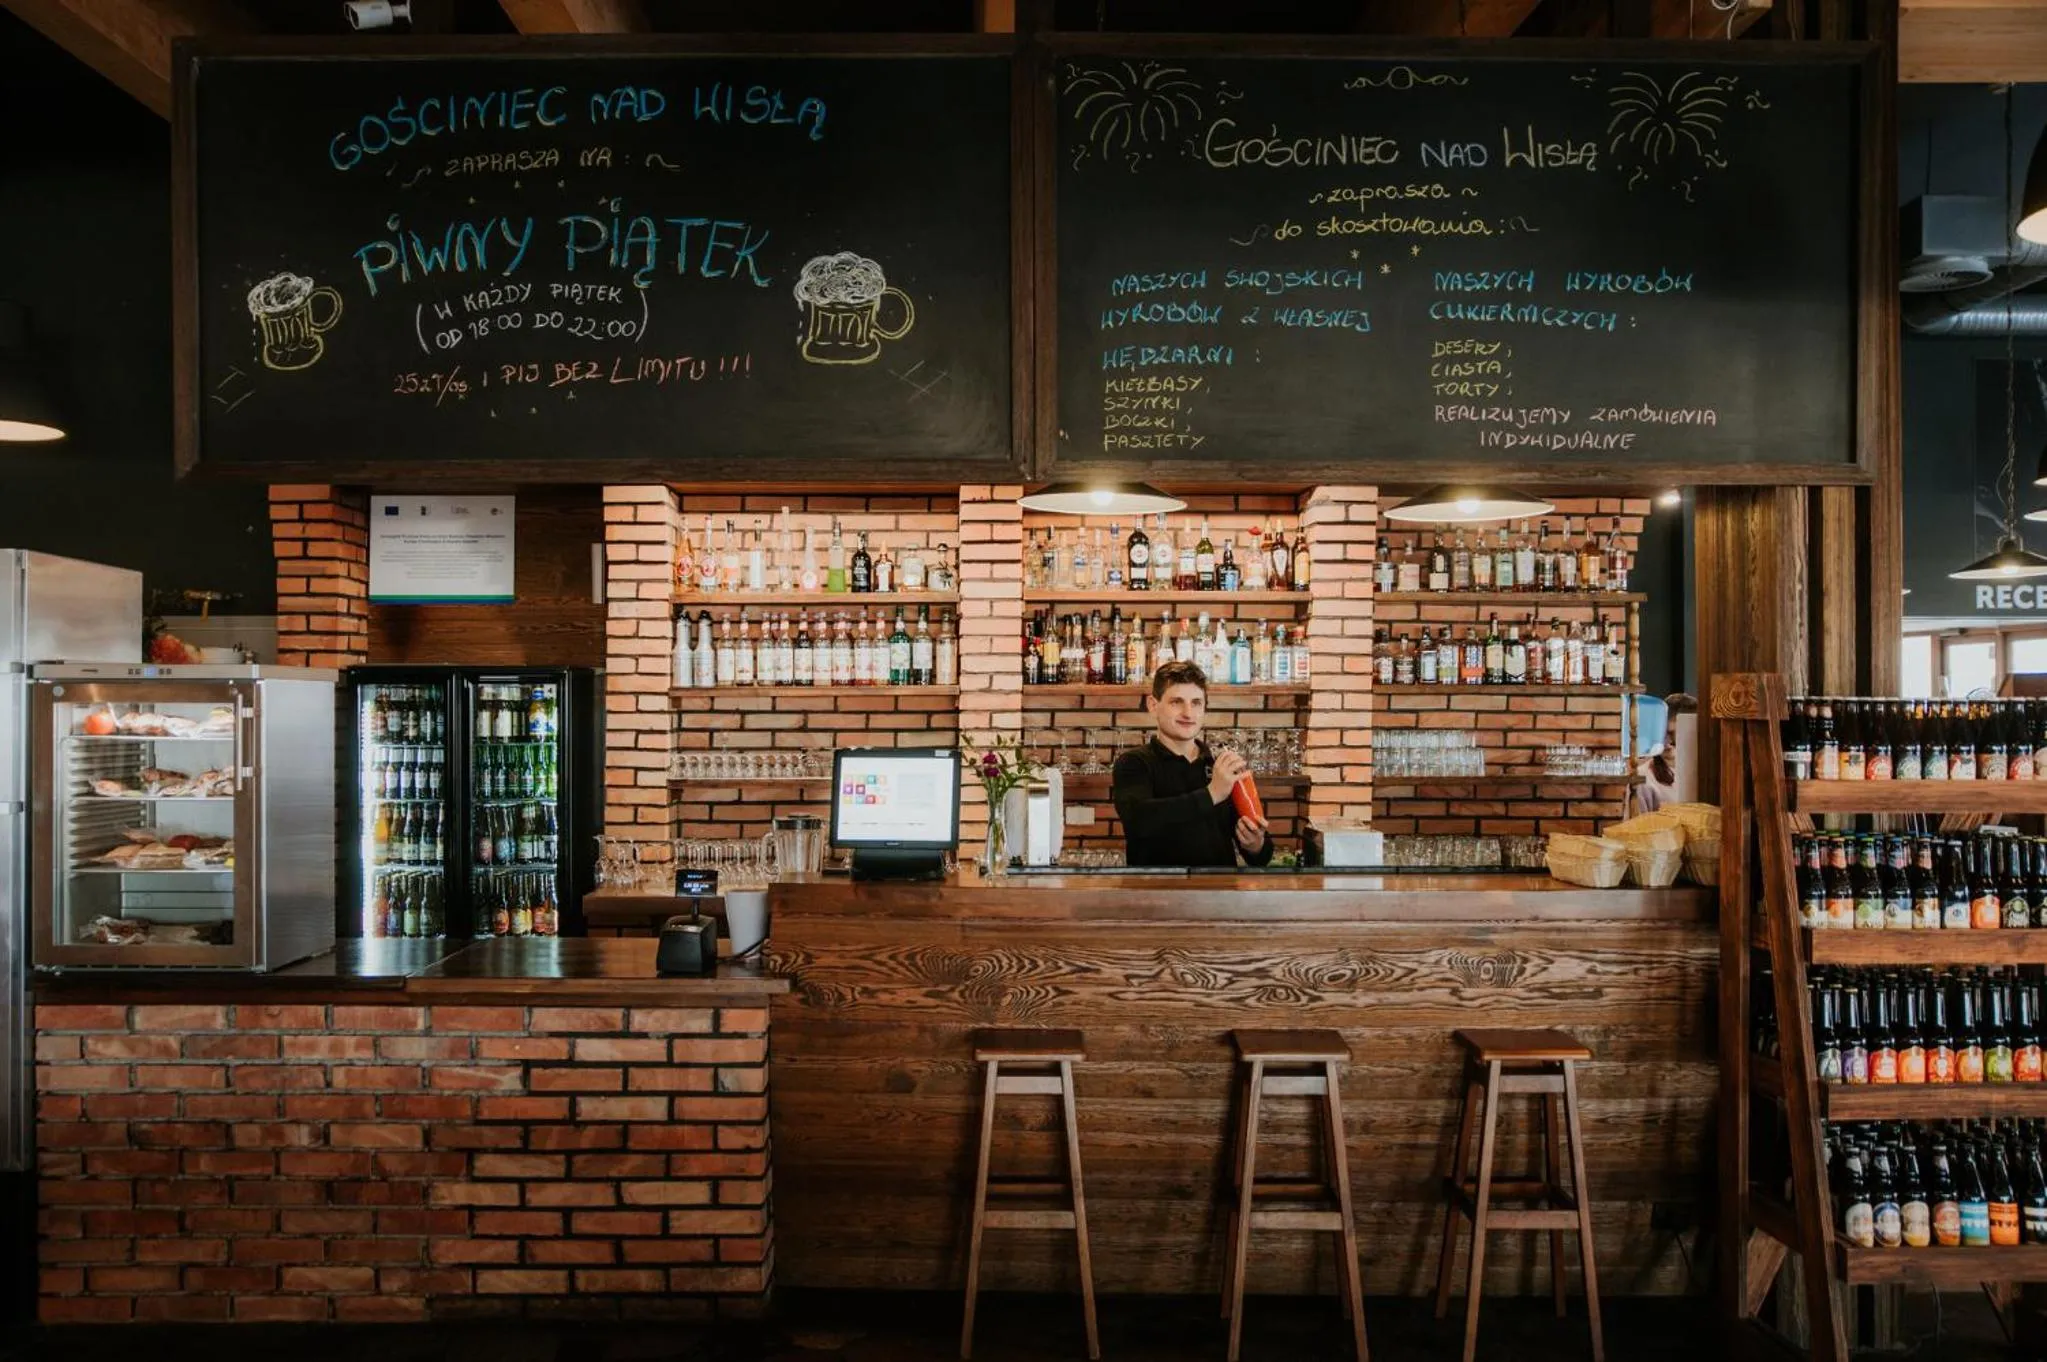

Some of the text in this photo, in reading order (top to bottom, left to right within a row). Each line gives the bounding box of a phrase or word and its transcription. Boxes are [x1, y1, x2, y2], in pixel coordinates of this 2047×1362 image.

[591, 85, 665, 124] NAD
[444, 148, 559, 177] ZAPRASZA
[579, 147, 612, 169] NA
[1420, 141, 1488, 168] NAD
[1327, 183, 1451, 213] zaprasza
[1274, 219, 1302, 241] do
[353, 197, 773, 296] PIWNY PIĄTEK
[1111, 269, 1363, 297] NASZYCH SWOJSKICH
[1433, 267, 1694, 293] NASZYCH WYROBÓW
[463, 282, 532, 312] KAŻDY
[550, 283, 622, 305] PIĄTEK
[436, 329, 463, 349] OD
[535, 310, 564, 329] DO
[1101, 299, 1223, 331] WYROBÓW
[1274, 307, 1371, 333] WŁASNEJ
[548, 361, 604, 388] BEZ
[609, 355, 706, 385] LIMITU
[1434, 402, 1717, 429] REALIZUJEMY ZAMÓWIENIA
[1103, 433, 1205, 452] PASZTETY
[1479, 430, 1636, 451] INDYWIDUALNE
